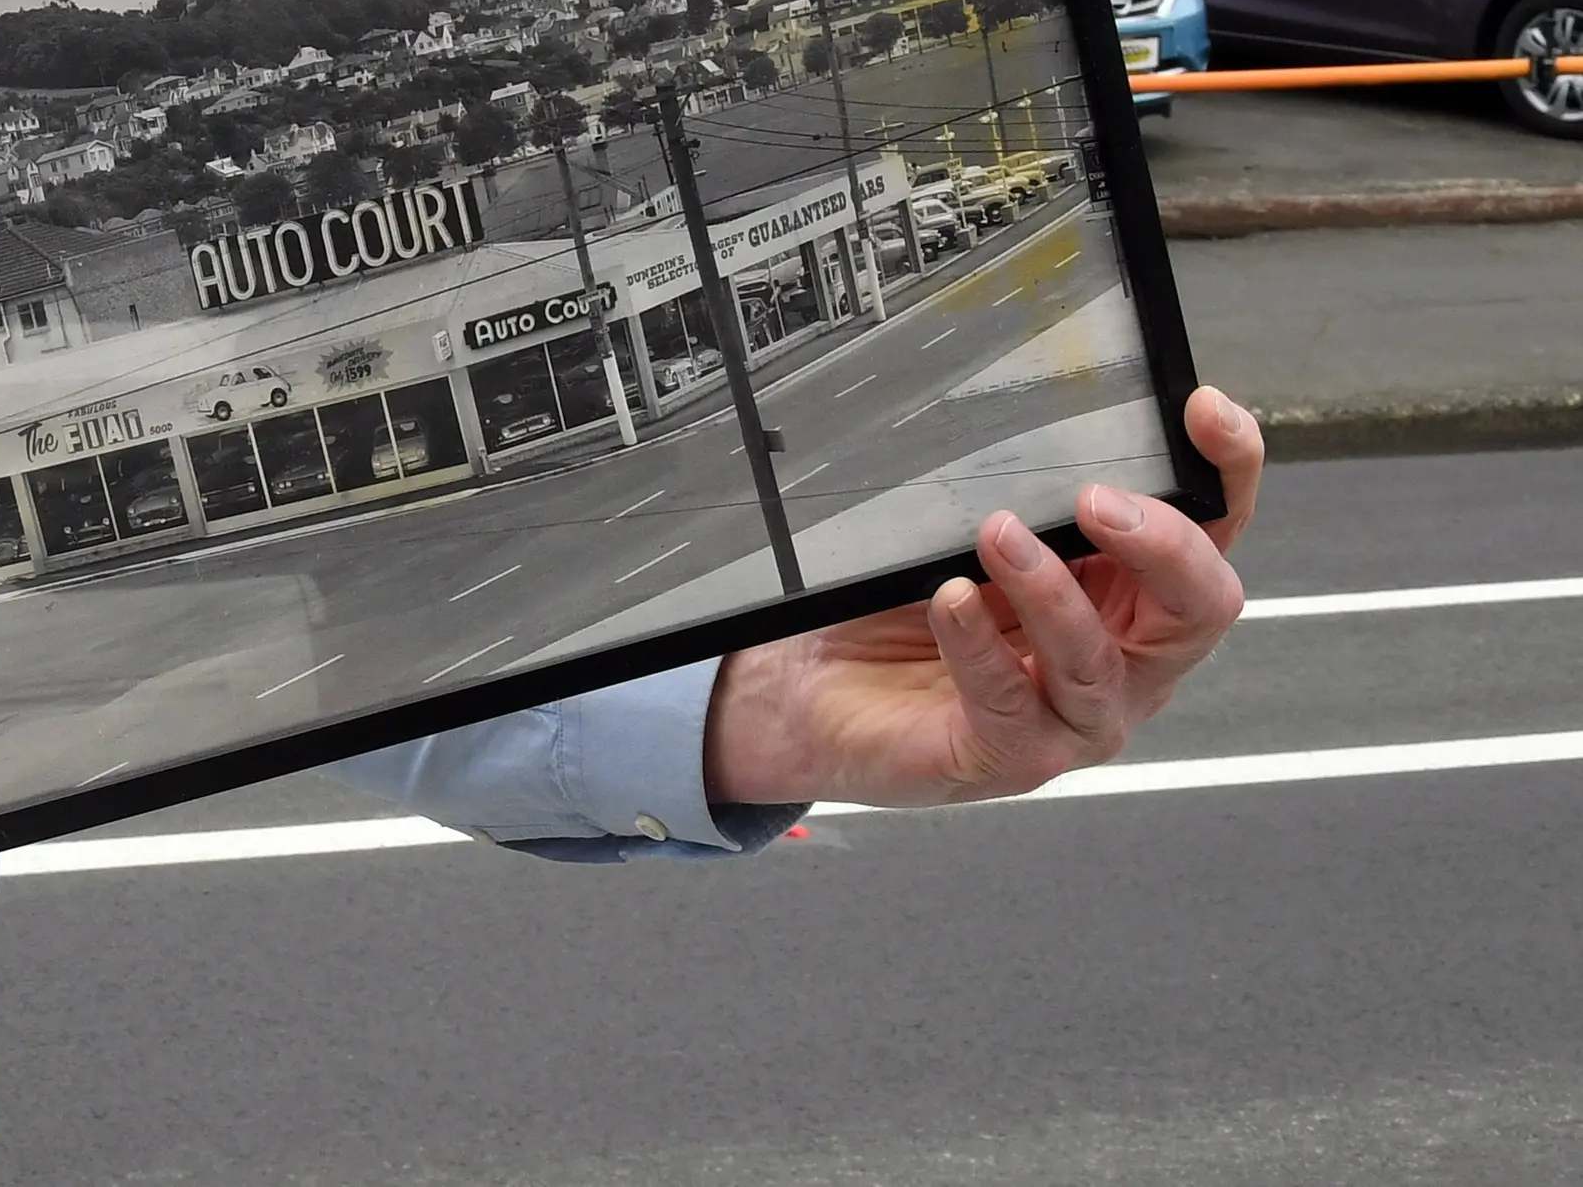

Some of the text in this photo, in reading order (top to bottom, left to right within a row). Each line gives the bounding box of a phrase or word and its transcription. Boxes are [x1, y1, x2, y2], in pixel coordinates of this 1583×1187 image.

[748, 175, 886, 249] GUARANTEED ARS
[191, 178, 480, 310] AUTO COURT
[710, 231, 745, 253] RGEST
[720, 246, 735, 260] OF
[626, 254, 686, 286] DUNEDIN'S
[647, 262, 699, 290] SELECTI
[544, 288, 612, 325] COUT
[68, 400, 118, 419] FABULOUS
[18, 420, 59, 463] The
[62, 408, 145, 455] FIAT
